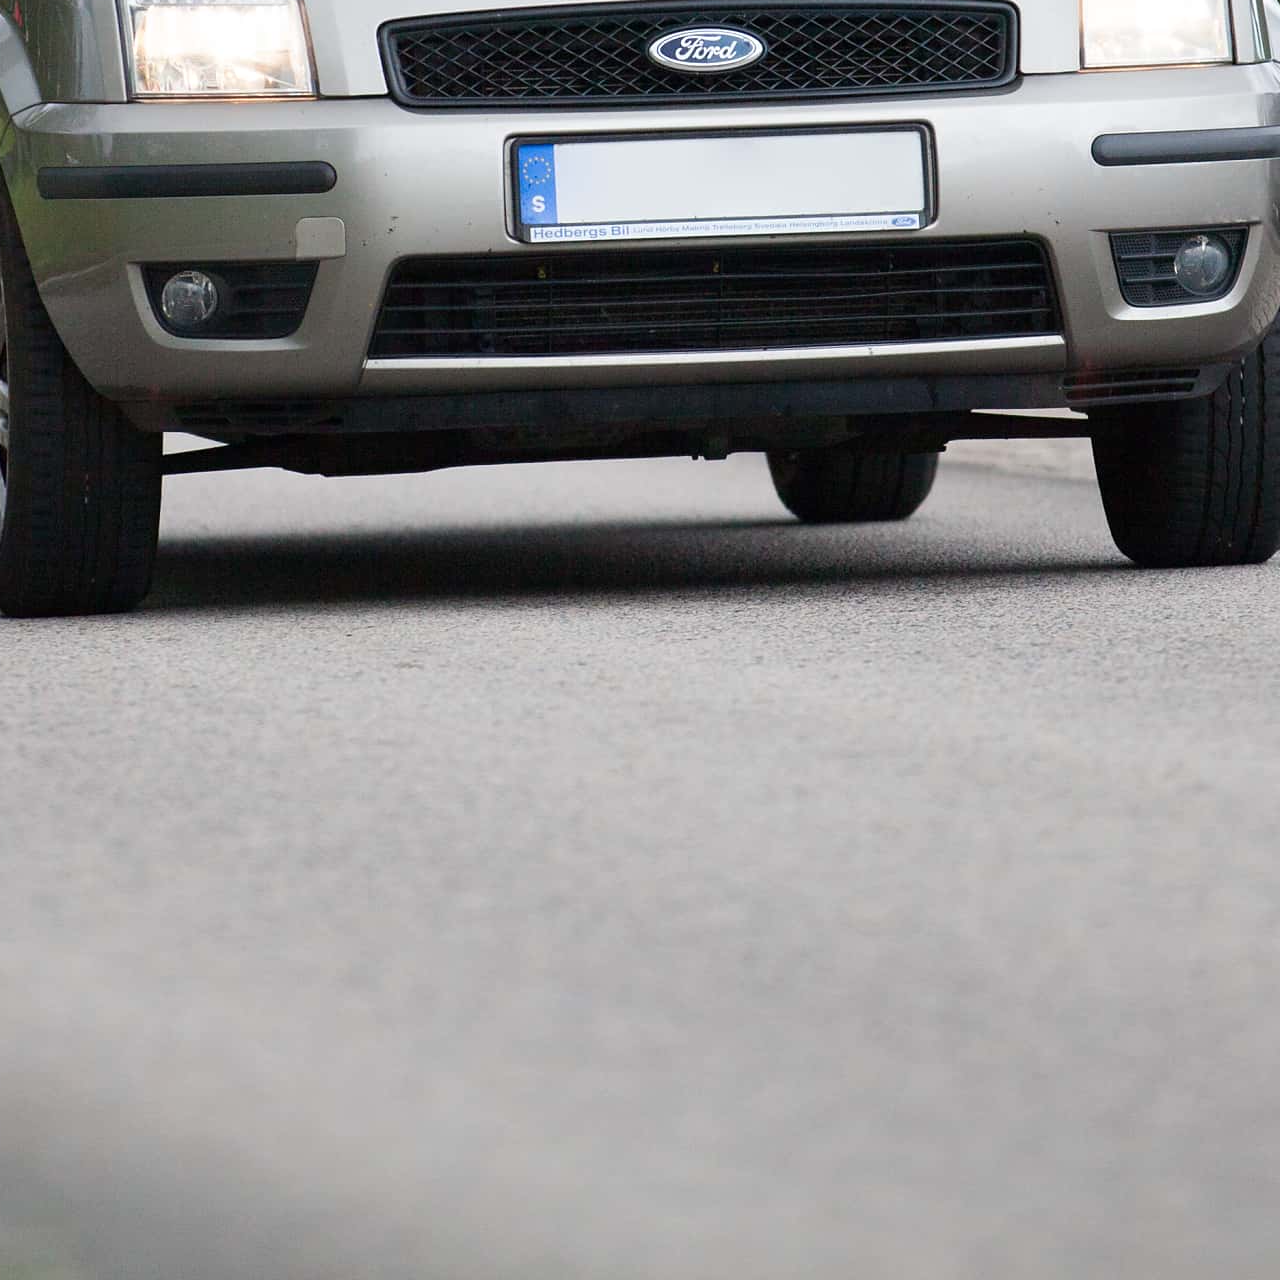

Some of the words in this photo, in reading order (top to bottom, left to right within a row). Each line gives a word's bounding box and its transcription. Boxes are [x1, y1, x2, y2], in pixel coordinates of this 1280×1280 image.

[675, 35, 737, 61] Ford
[531, 195, 546, 213] S
[533, 226, 608, 239] Hedbergs
[611, 225, 630, 236] Bil
